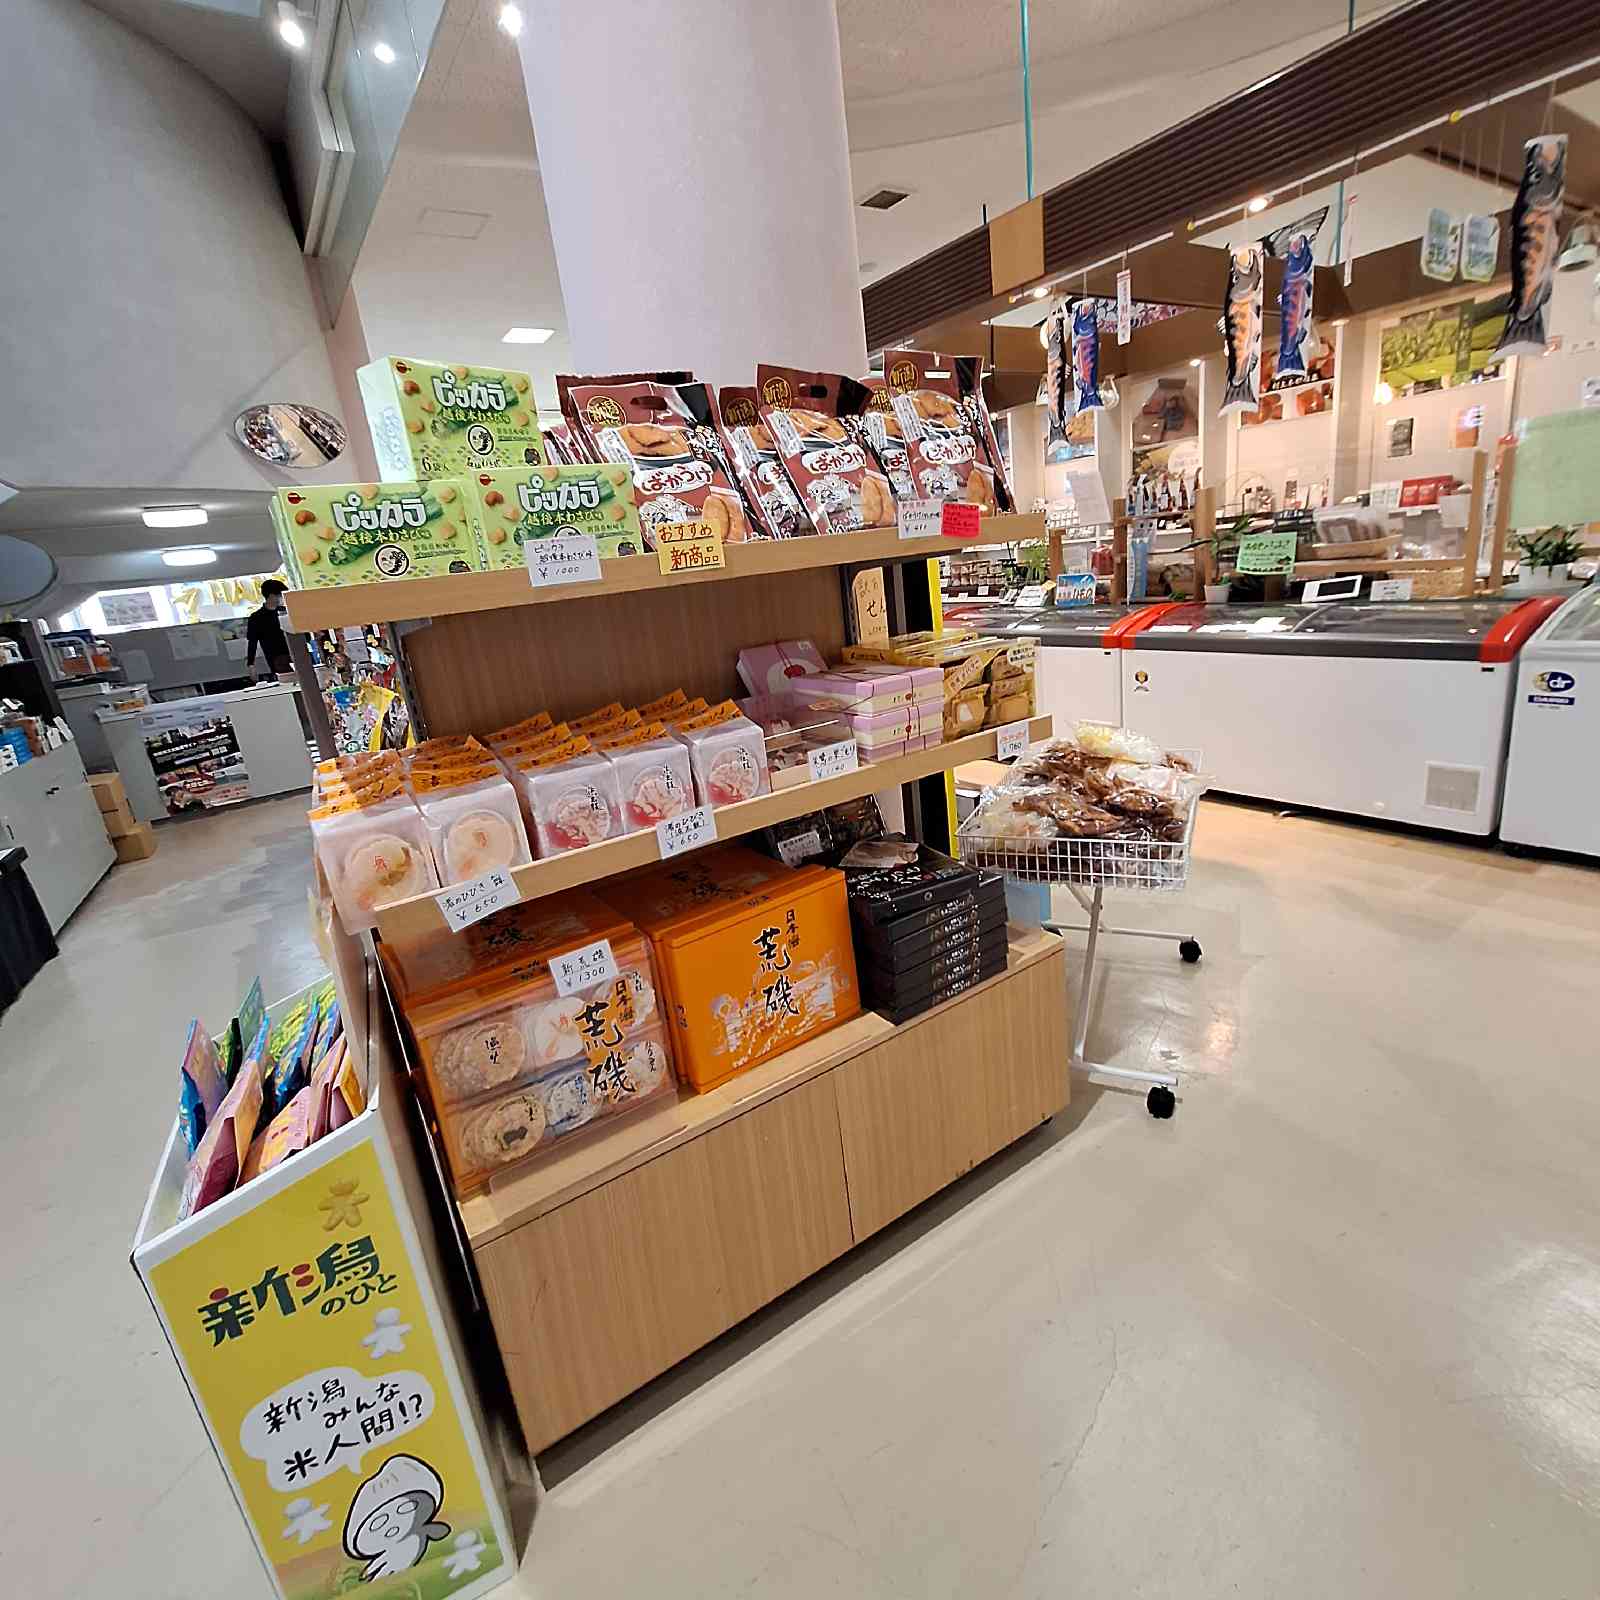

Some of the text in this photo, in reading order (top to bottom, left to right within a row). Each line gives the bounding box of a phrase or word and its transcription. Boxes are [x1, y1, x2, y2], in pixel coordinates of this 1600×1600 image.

[432, 370, 507, 411] ピッカラ
[642, 463, 712, 492] ばかうけ
[809, 448, 865, 473] ばかうけ
[332, 494, 427, 531] ピッカラ
[517, 475, 600, 513] ピッカラ
[658, 522, 713, 541] おすすめ
[555, 566, 580, 576] 1000
[671, 545, 720, 569] 新商品
[579, 966, 606, 983] 1300
[753, 927, 800, 1019] 荒磯
[574, 1000, 637, 1100] 荒磯
[198, 1234, 382, 1349] 新潟
[320, 1271, 399, 1318] のひと
[262, 1376, 347, 1436] 新潟
[322, 1380, 402, 1431] みんな
